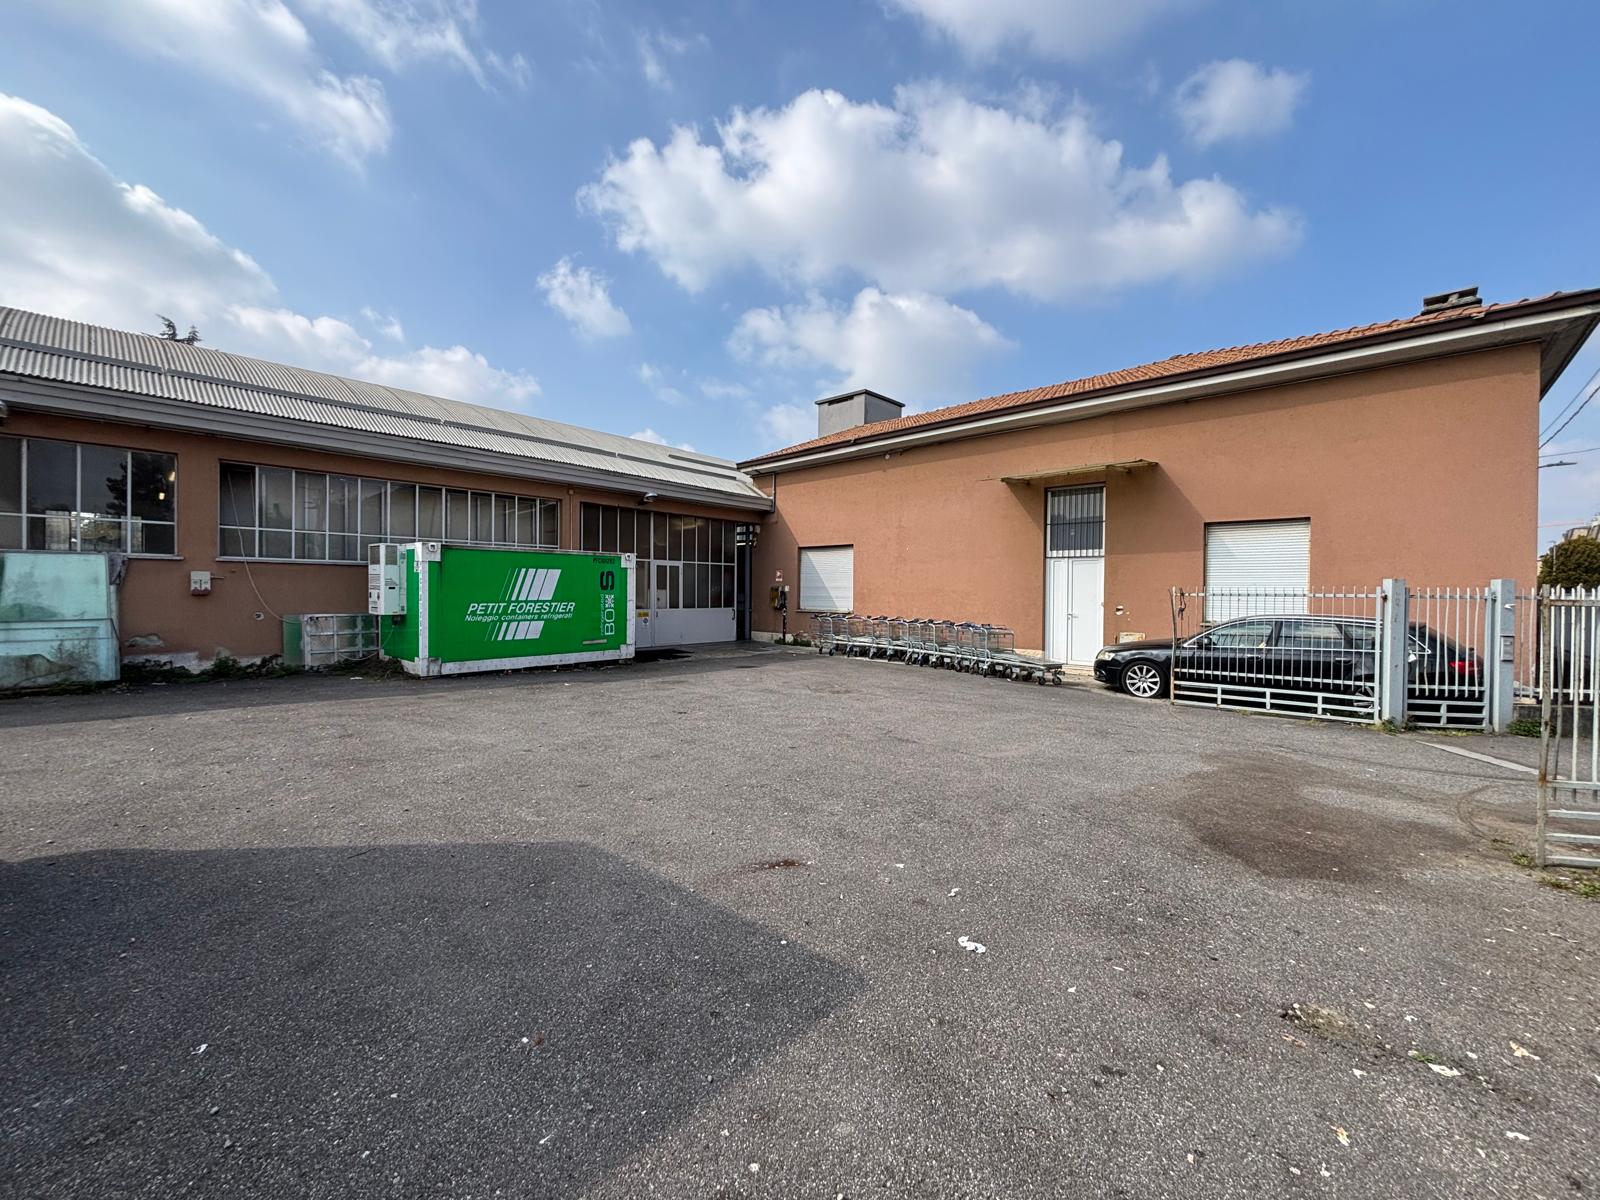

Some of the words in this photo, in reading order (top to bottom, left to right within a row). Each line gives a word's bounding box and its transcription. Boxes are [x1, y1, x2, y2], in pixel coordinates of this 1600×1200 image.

[467, 603, 507, 614] PETIT
[507, 602, 576, 614] FORESTIER
[465, 614, 499, 623] Noleggio
[501, 613, 539, 621] containers
[540, 612, 573, 620] refrigerati
